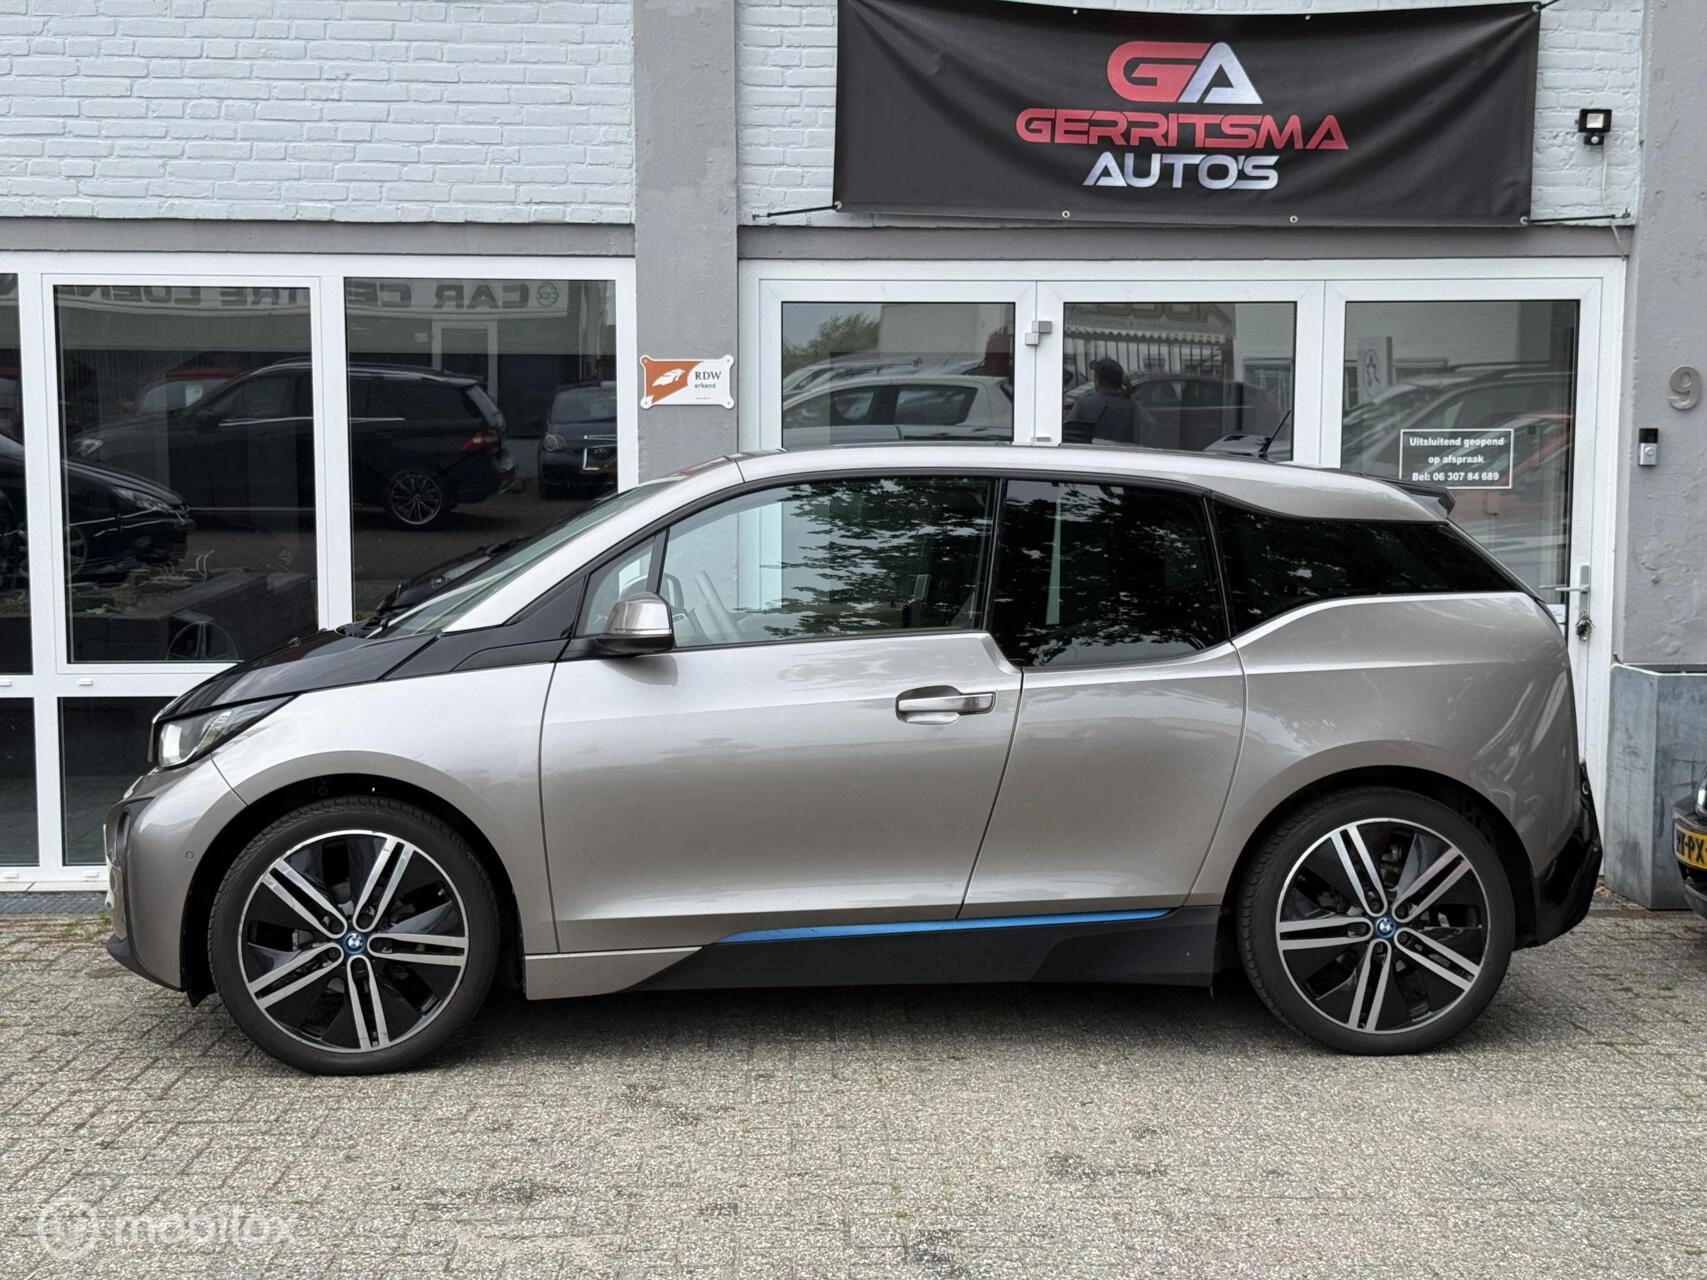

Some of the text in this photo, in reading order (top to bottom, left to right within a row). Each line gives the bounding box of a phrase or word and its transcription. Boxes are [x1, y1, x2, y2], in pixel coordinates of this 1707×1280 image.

[1107, 41, 1263, 104] GA
[1015, 107, 1349, 150] GERRITSMA
[1082, 151, 1280, 190] AUTO'S
[694, 371, 722, 380] RDW
[1668, 364, 1702, 411] 9
[1409, 437, 1504, 448] Uitsluitend geopend
[1428, 454, 1484, 465] op afspraak
[1412, 472, 1499, 481] Bel: 06 307 84 689
